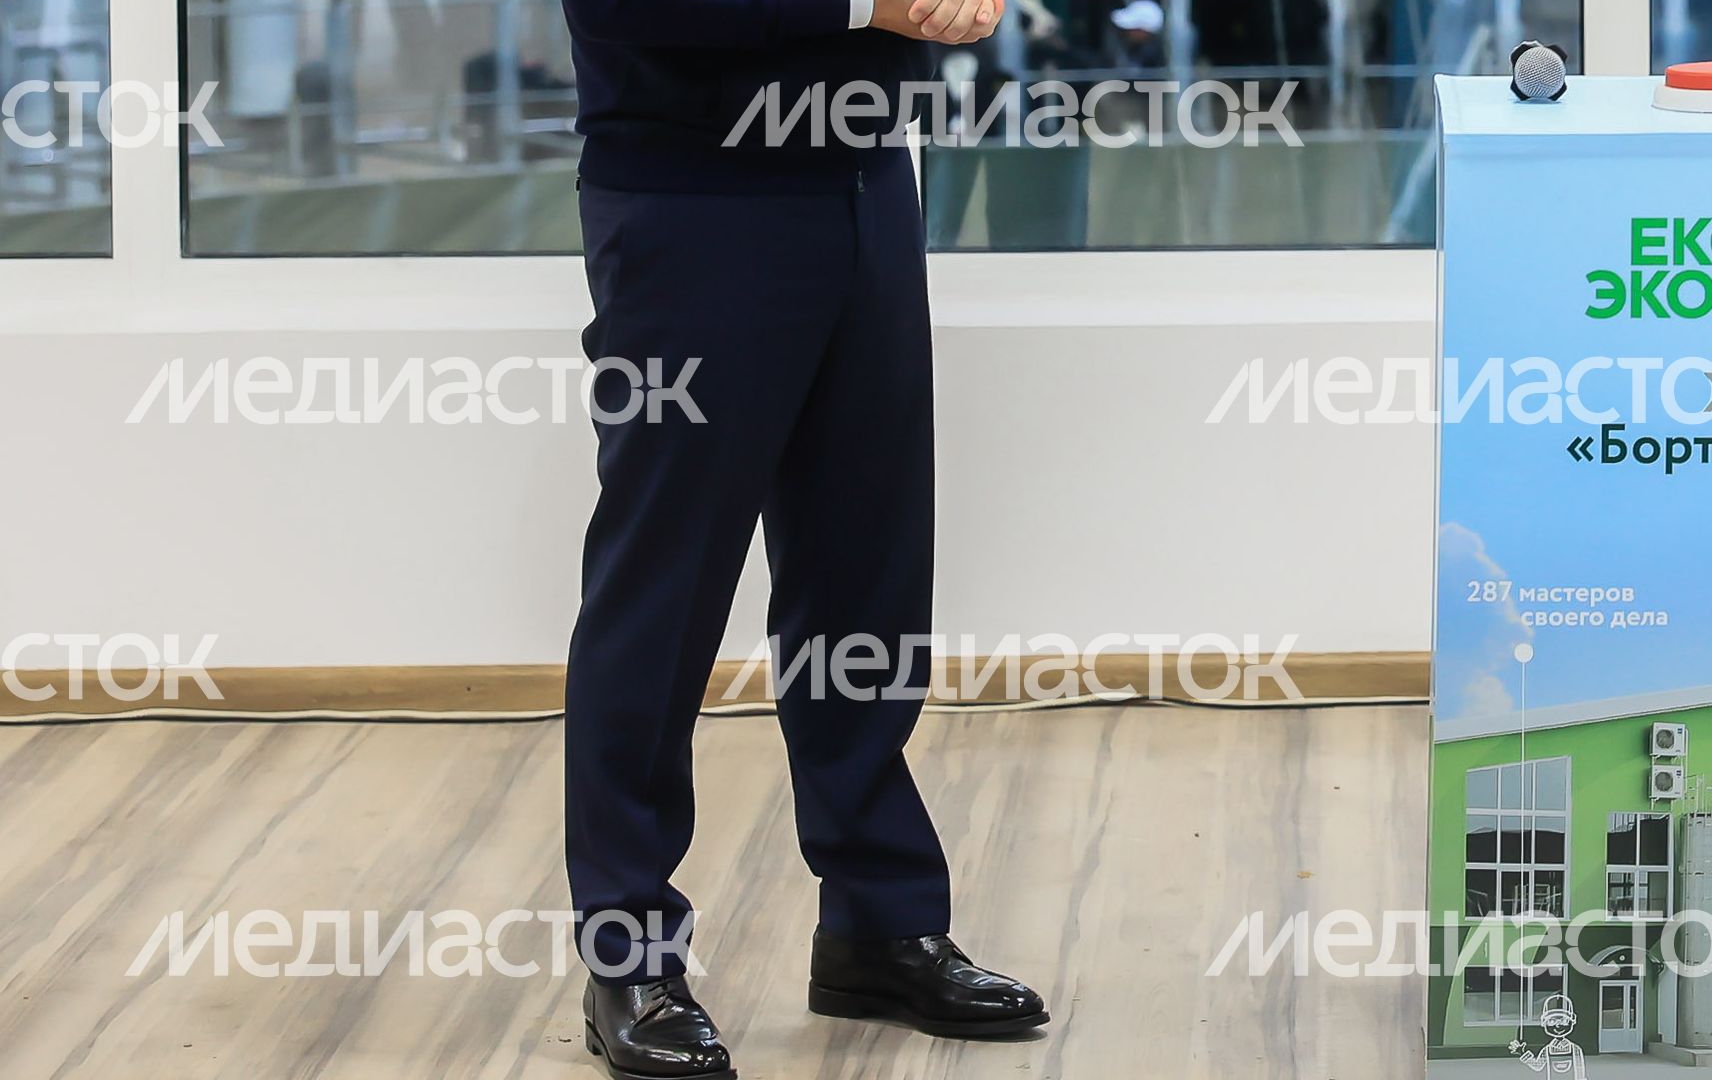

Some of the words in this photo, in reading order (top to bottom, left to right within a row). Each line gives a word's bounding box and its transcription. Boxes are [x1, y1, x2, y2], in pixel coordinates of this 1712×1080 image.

[1467, 580, 1513, 603] 287
[1519, 587, 1635, 607] мастеров
[1521, 611, 1605, 627] своего
[1610, 611, 1669, 629] дела
